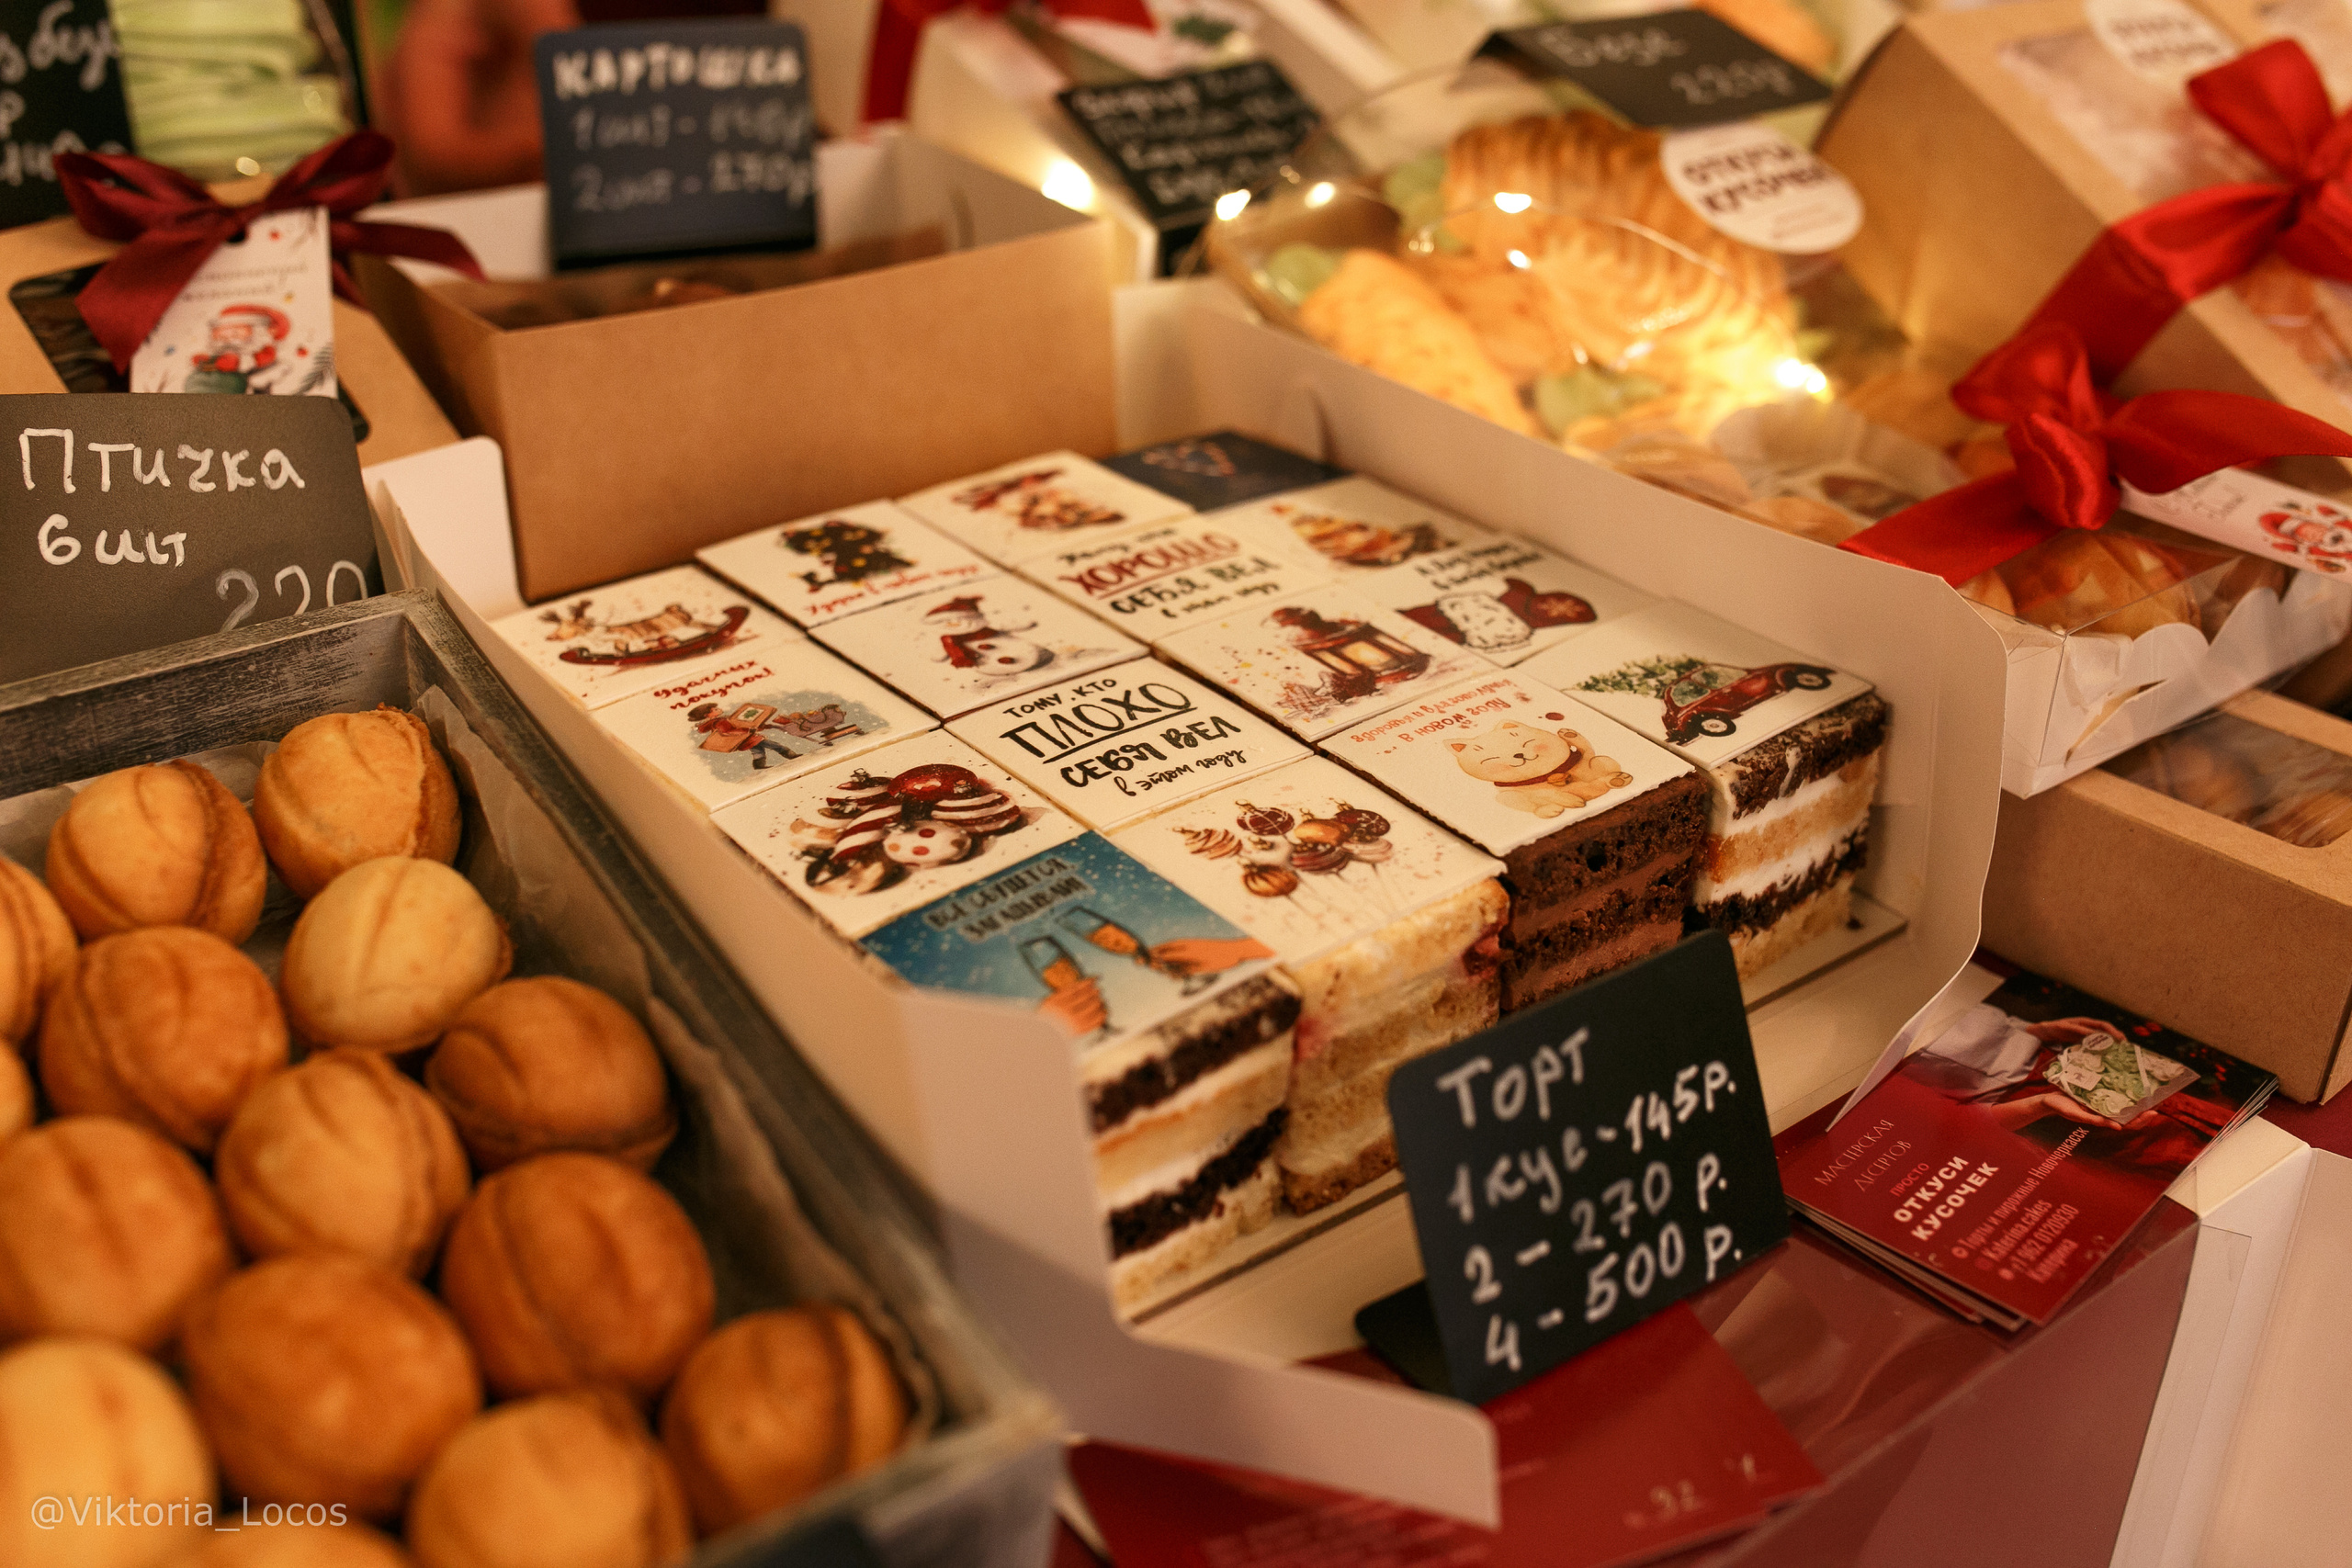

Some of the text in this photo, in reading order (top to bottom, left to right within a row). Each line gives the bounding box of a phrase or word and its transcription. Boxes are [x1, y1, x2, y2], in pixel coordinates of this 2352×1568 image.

[553, 41, 801, 101] КАРТОШКА
[18, 428, 306, 494] Птичка
[1057, 533, 1239, 595] ХОРОШО
[654, 661, 756, 698] Удачных
[1074, 679, 1117, 698] КТО
[999, 682, 1191, 758] ПЛОХО
[1060, 716, 1241, 787] СЕБЯ ВЕЛ
[1114, 750, 1247, 796] в этом году
[1889, 1162, 1930, 1197] ПРОСТО
[1893, 1156, 1969, 1223] ОТКУСИ
[1910, 1162, 1999, 1241] КУСОЧЕК
[1993, 1176, 2041, 1219] пирожные
[2028, 1126, 2089, 1180] Новочеркасск
[1464, 1245, 1502, 1304] 2
[1570, 1160, 1673, 1254] 270
[1485, 1314, 1522, 1371] 4
[1585, 1222, 1686, 1323] 500
